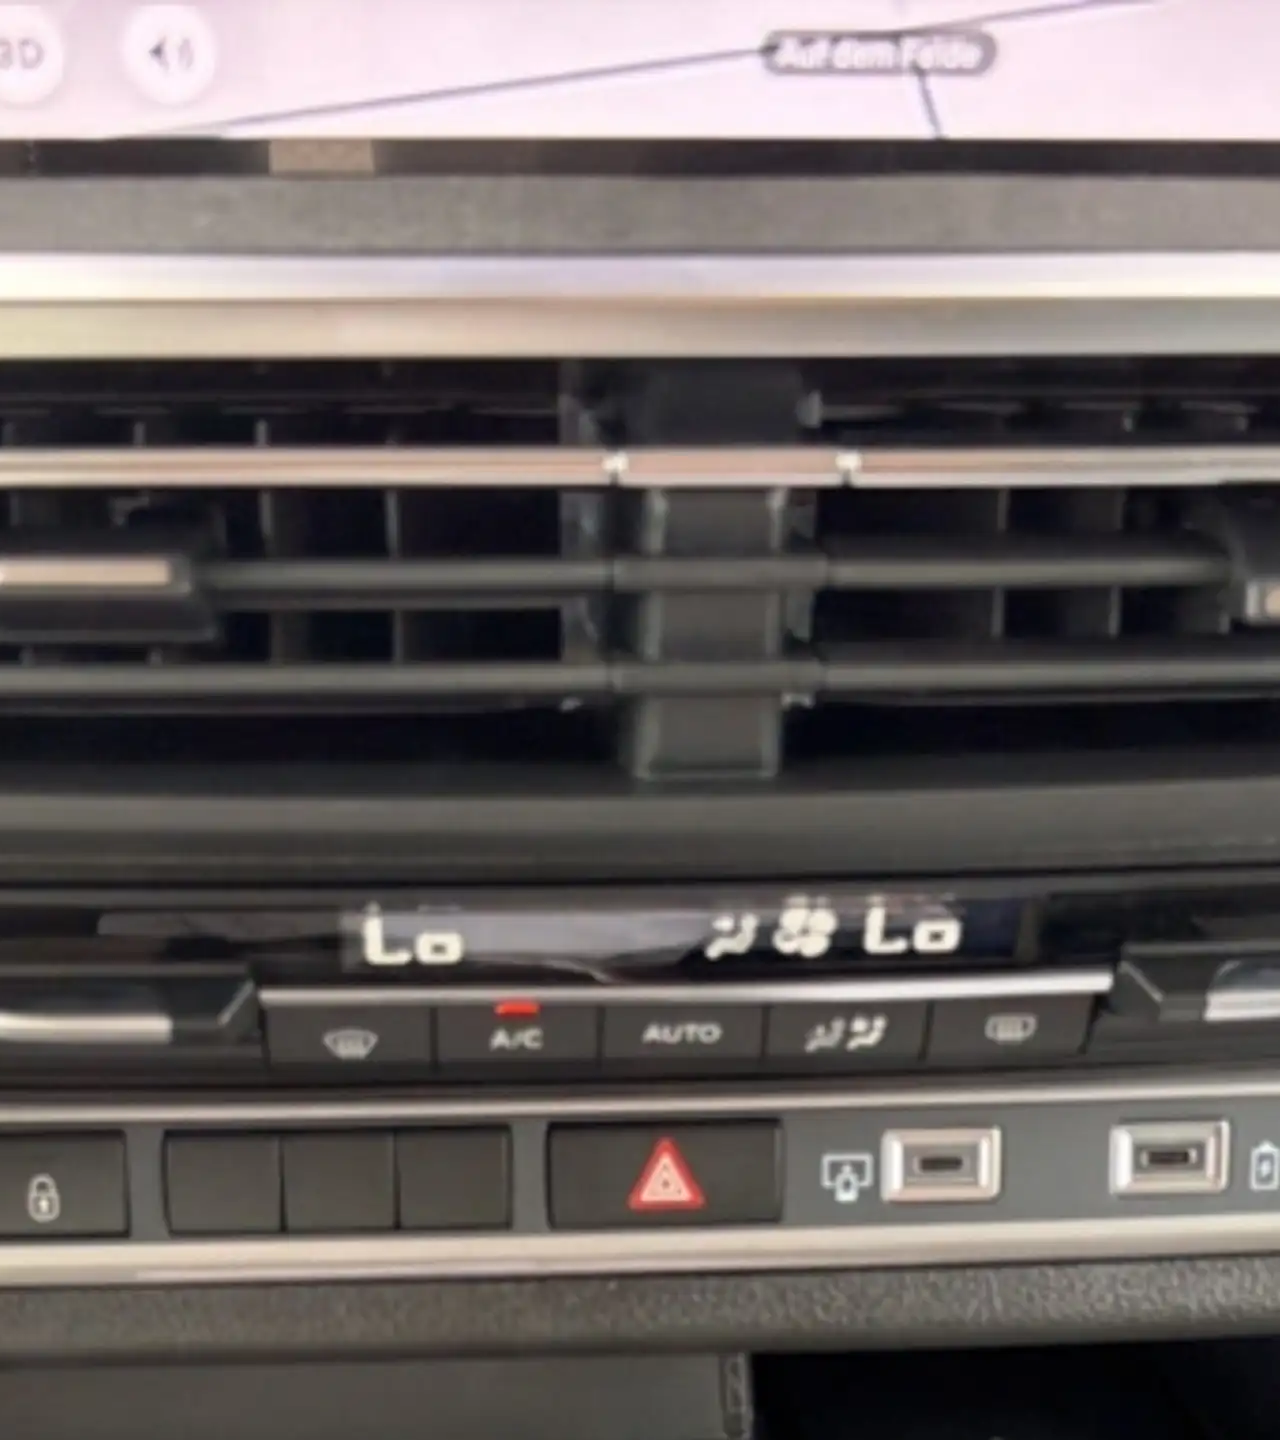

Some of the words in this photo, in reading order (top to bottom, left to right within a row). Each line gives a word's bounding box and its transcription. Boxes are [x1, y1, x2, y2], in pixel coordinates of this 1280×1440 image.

[774, 37, 829, 69] Auf
[832, 37, 895, 69] dem
[363, 903, 463, 966] Lo
[863, 895, 962, 954] Lo
[489, 1026, 544, 1051] A/C
[641, 1021, 724, 1045] AUTO
